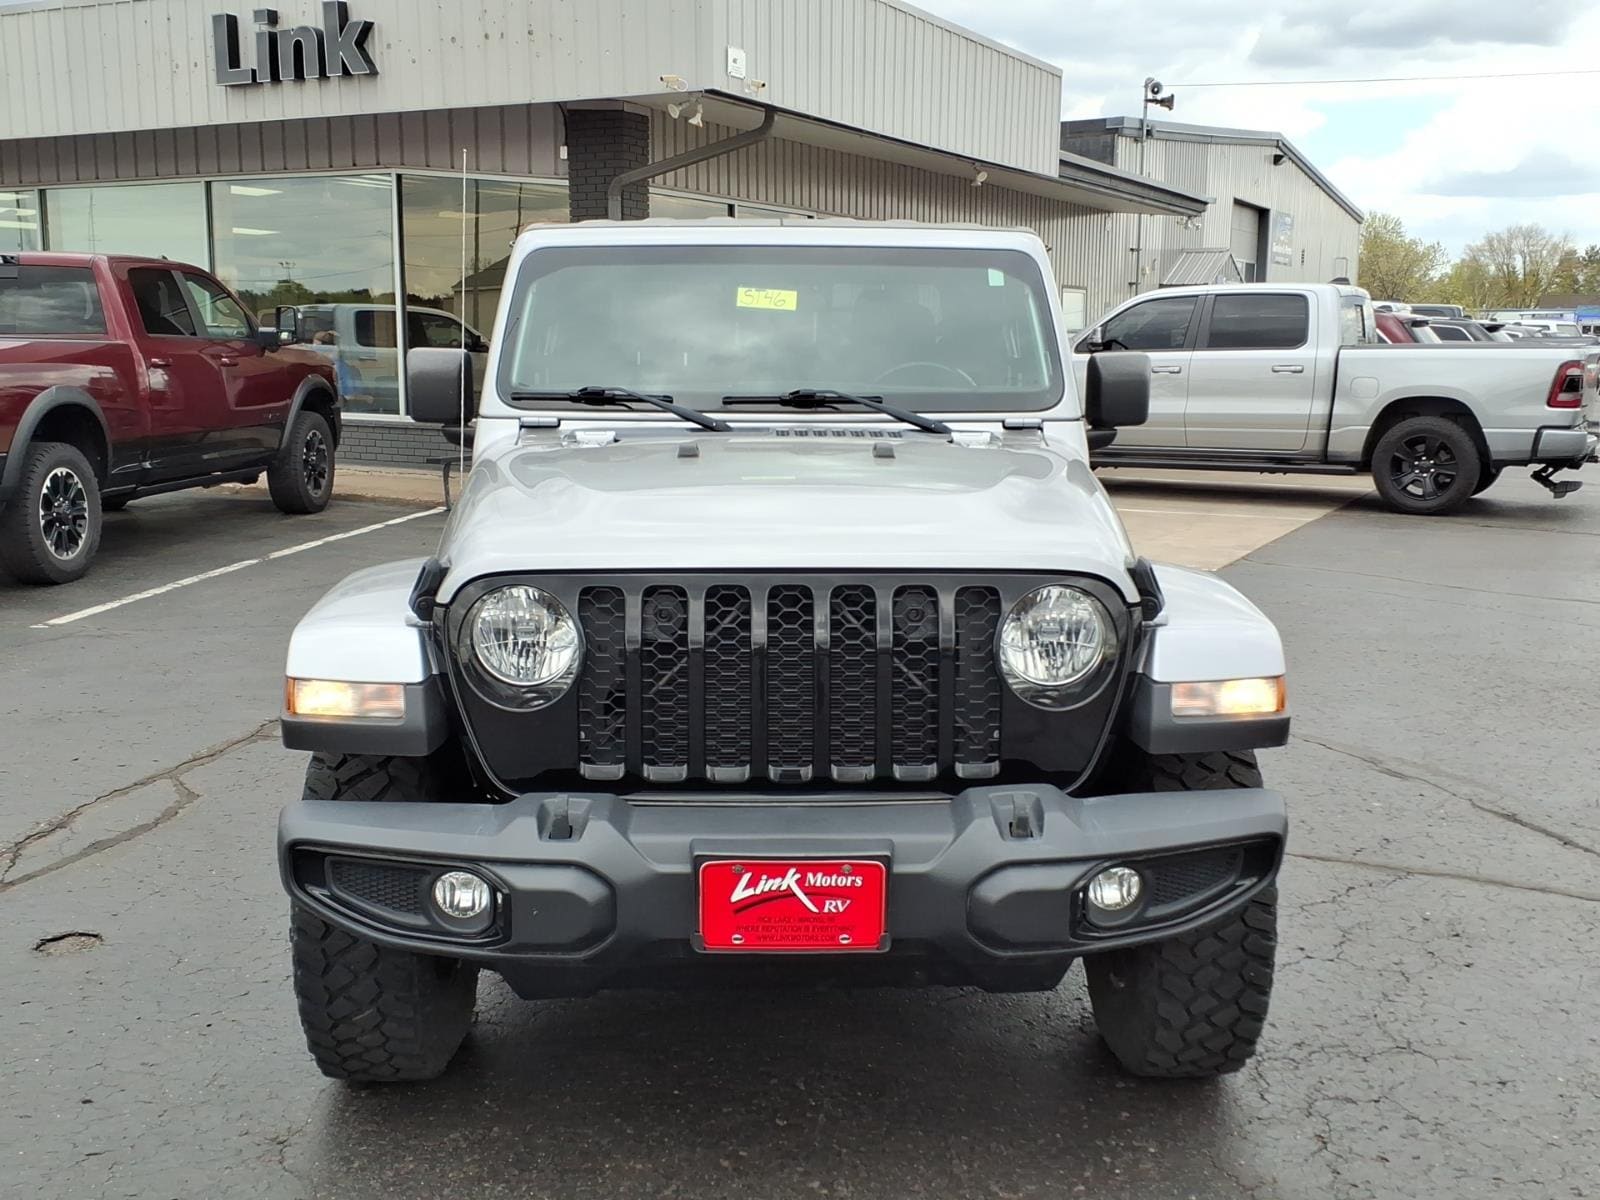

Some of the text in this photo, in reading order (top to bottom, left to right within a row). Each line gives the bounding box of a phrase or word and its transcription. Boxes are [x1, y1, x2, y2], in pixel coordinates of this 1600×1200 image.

[212, 0, 378, 86] Link
[730, 867, 863, 913] Link Motors
[822, 899, 851, 913] RV
